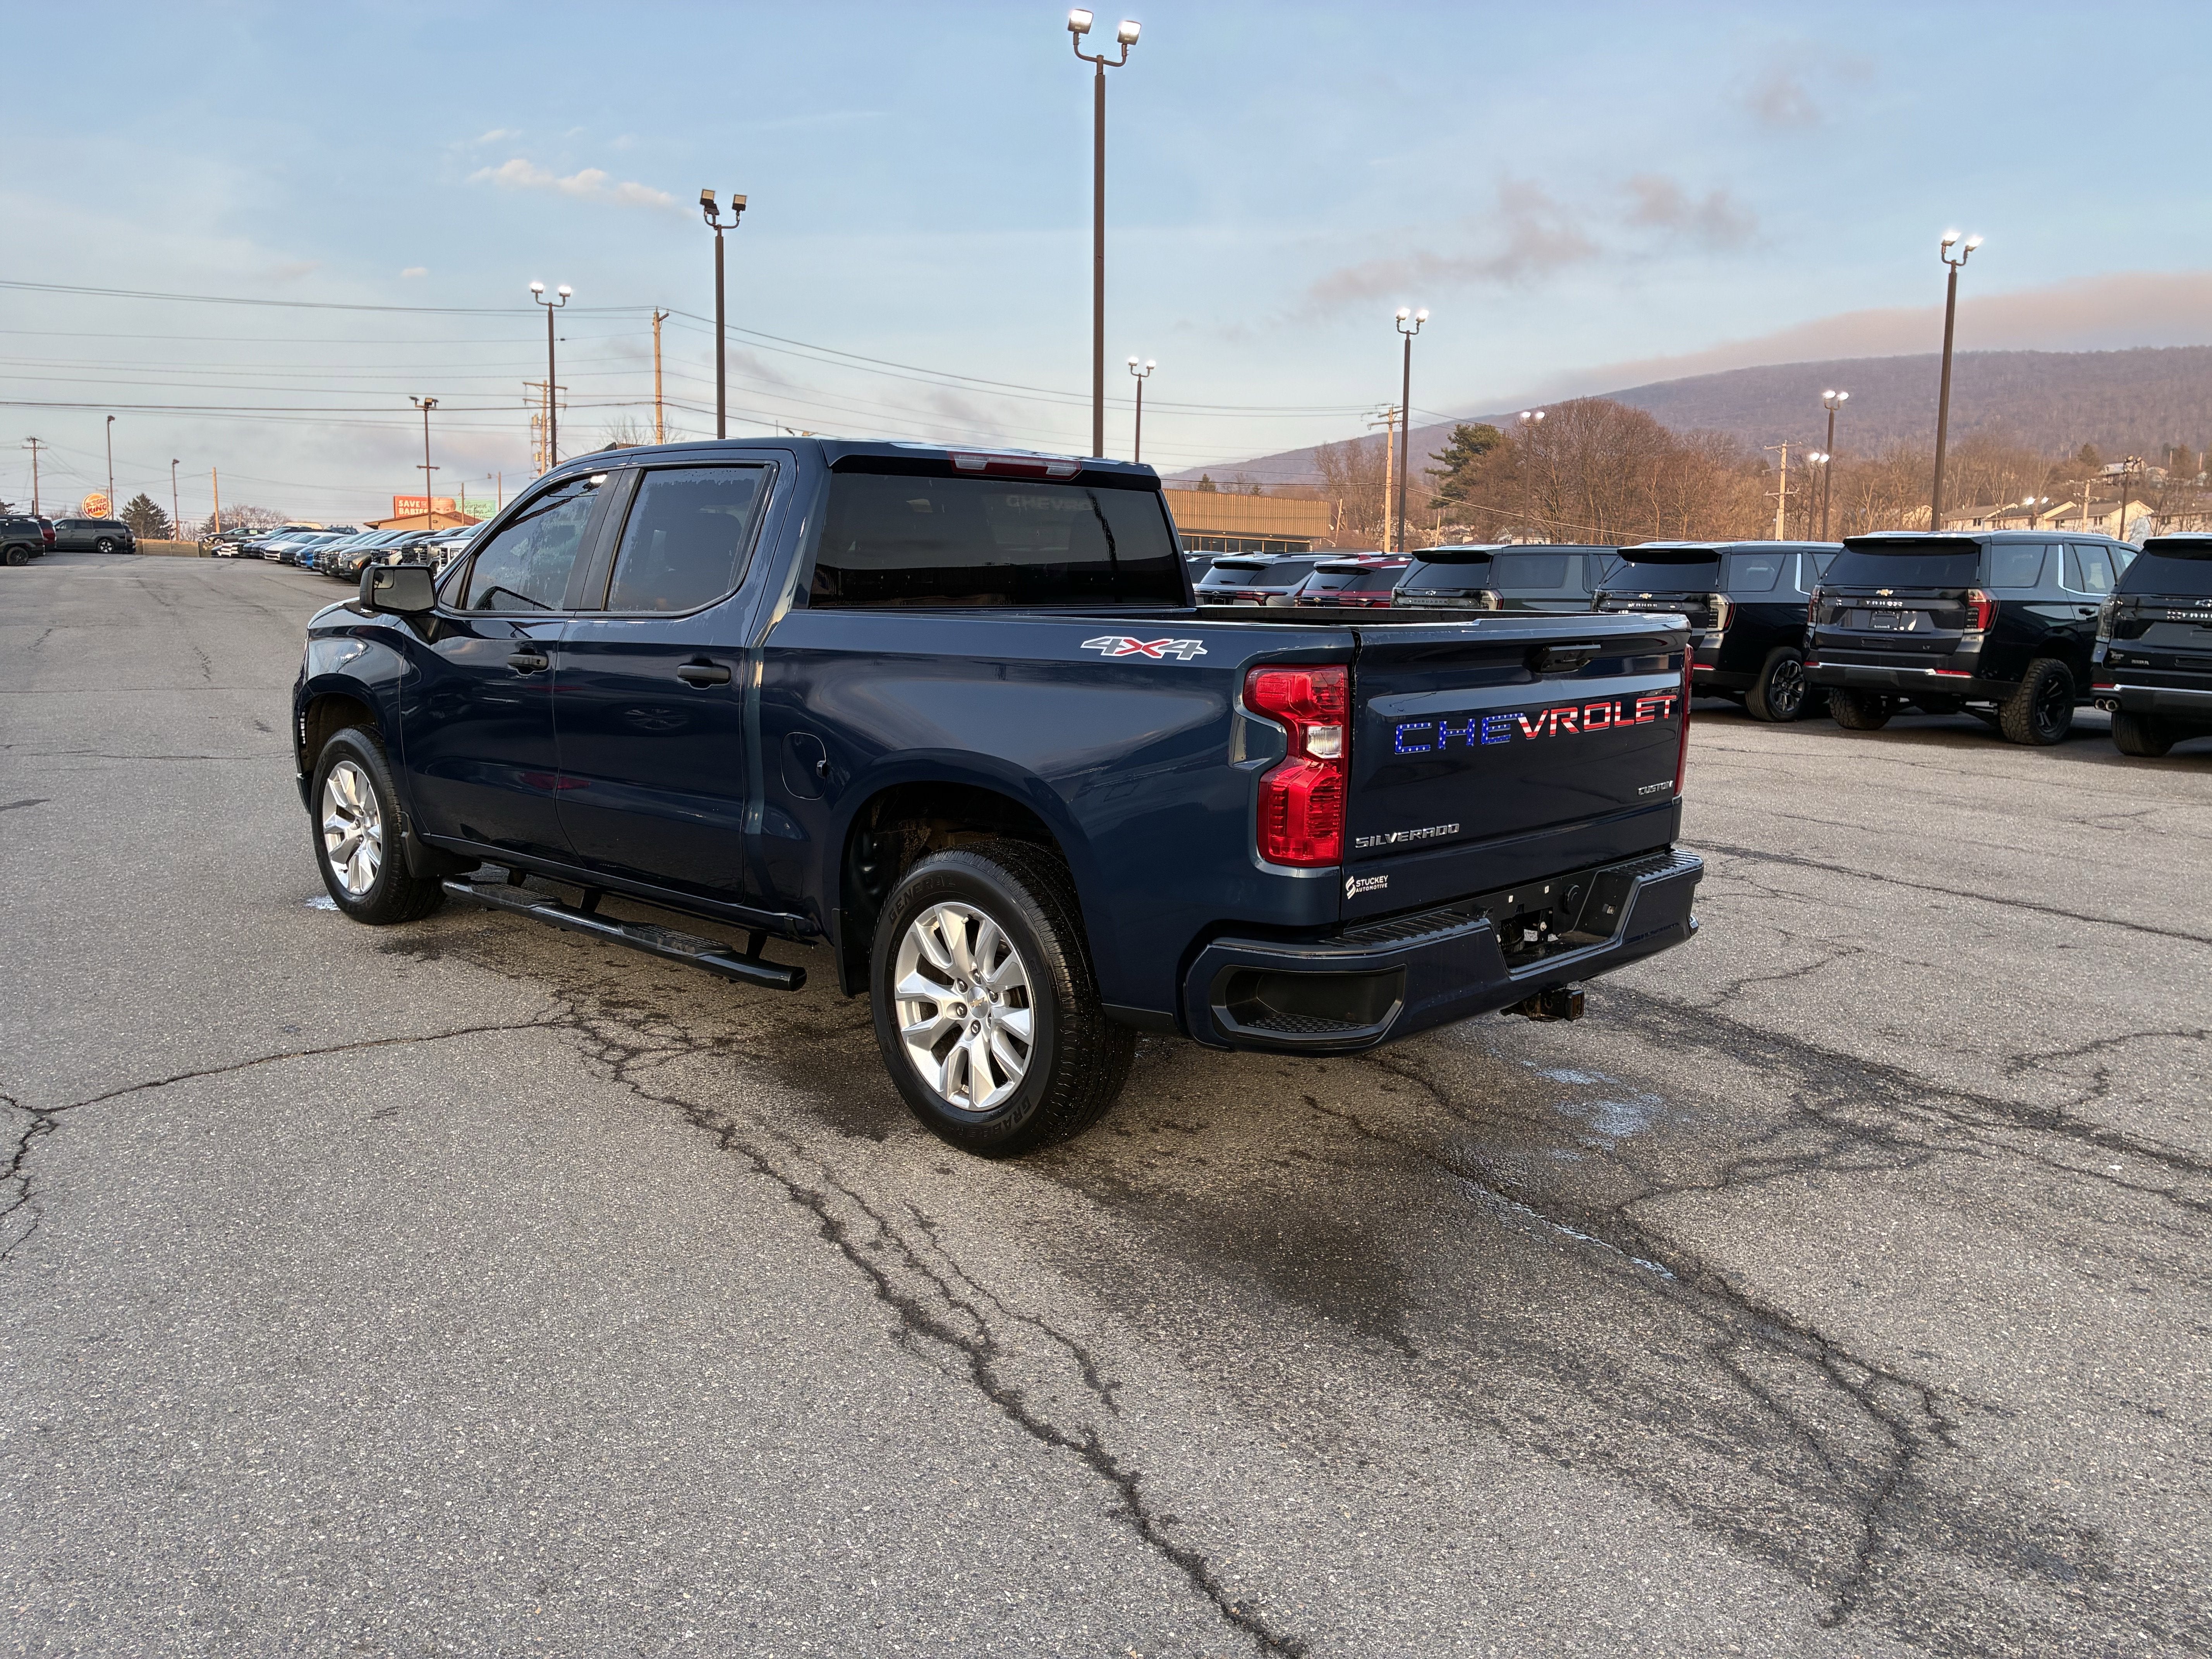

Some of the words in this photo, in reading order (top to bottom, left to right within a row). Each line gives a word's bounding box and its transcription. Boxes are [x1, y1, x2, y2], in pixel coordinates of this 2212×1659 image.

[86, 498, 107, 508] BURGER
[398, 500, 421, 508] SAVE
[88, 504, 107, 514] KING
[1395, 695, 1677, 754] CHEVROLET
[1638, 780, 1673, 795] CUSTOM
[1355, 823, 1460, 848] SILVERADO
[1356, 875, 1388, 887] STUCKEY
[1356, 883, 1388, 893] AUTOMOTIVE
